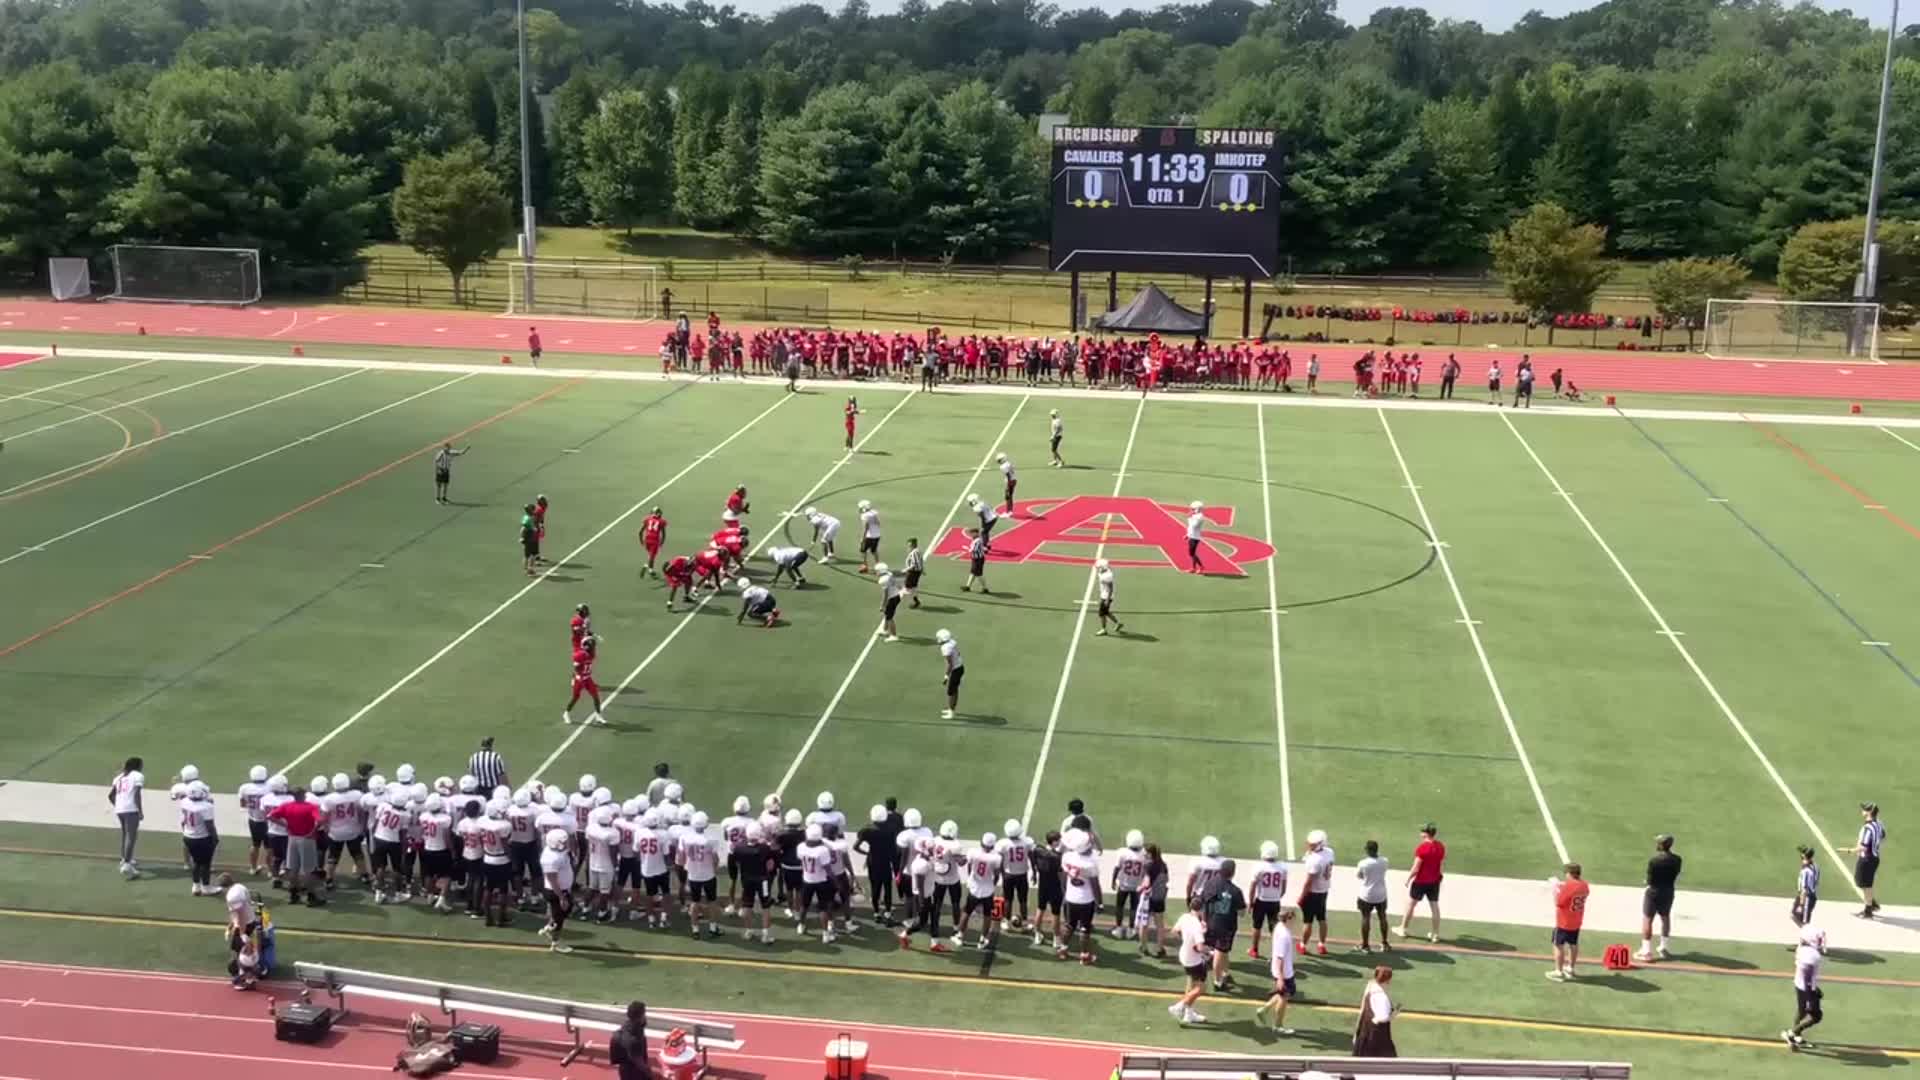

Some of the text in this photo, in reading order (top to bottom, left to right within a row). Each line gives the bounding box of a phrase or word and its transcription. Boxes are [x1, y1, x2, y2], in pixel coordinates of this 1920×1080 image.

[1055, 127, 1139, 143] ARCHBISHOP
[1203, 129, 1274, 145] SPALDING
[1064, 150, 1123, 164] CAVALIERS
[1214, 152, 1267, 167] IMHOTEP
[1129, 152, 1205, 183] 11:33
[1084, 170, 1102, 201] 0
[1229, 173, 1249, 204] 0
[1148, 188, 1184, 204] QTR 1
[382, 811, 400, 829] 30
[640, 837, 658, 855] 25
[1009, 846, 1025, 863] 15
[1124, 861, 1142, 877] 23
[1262, 871, 1281, 888] 38
[1609, 948, 1629, 967] 40
